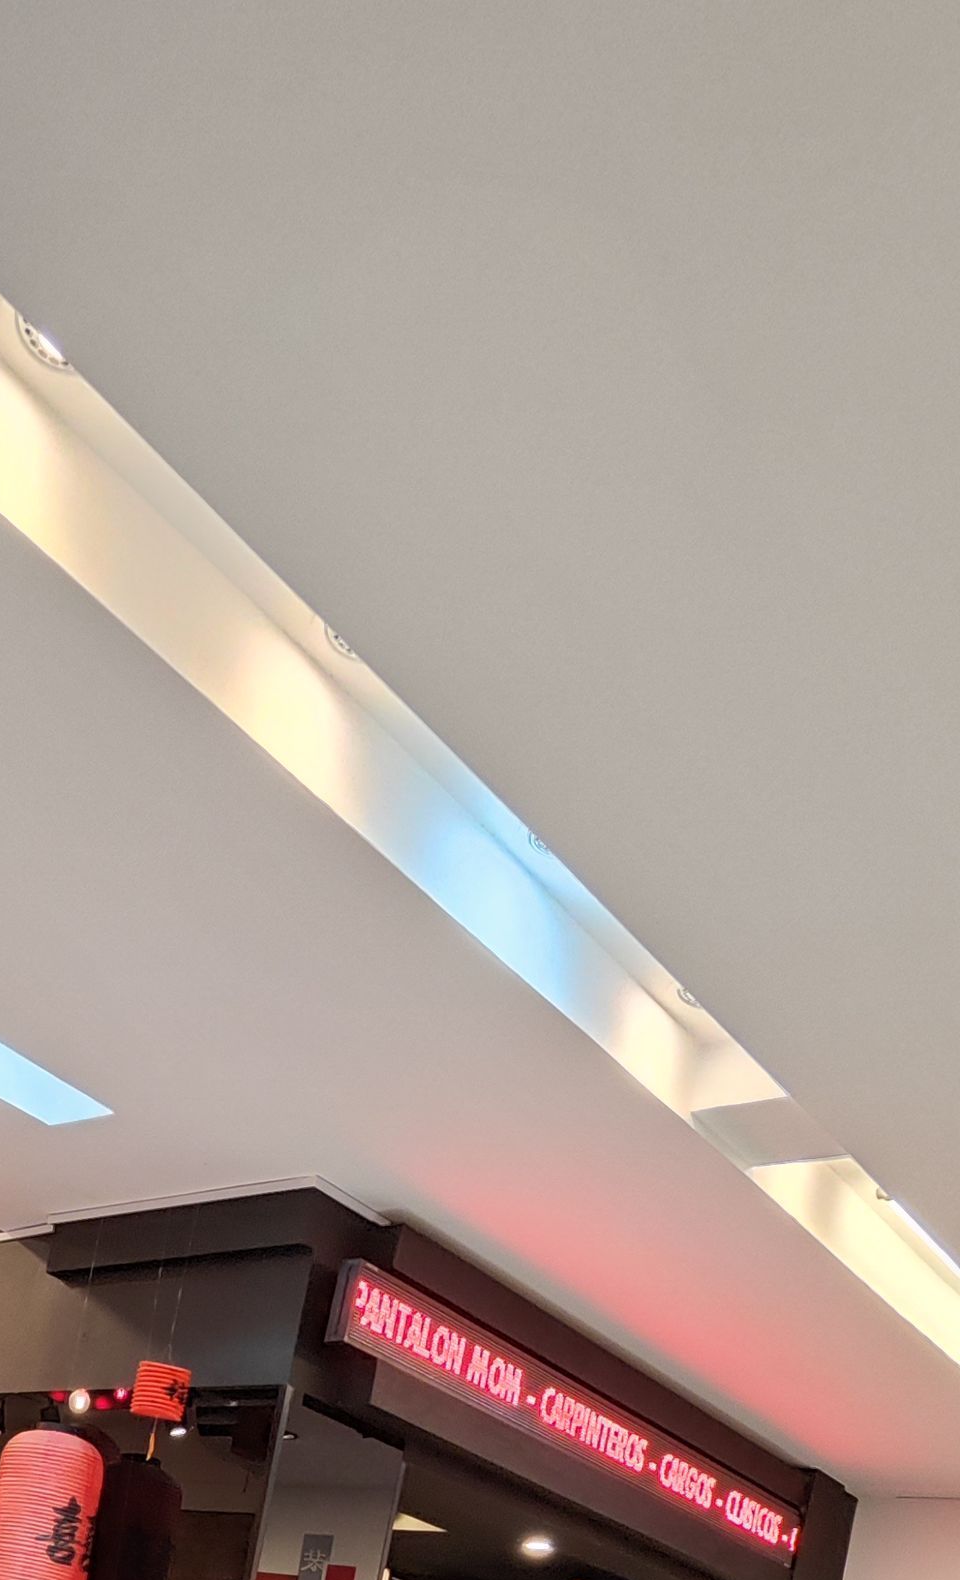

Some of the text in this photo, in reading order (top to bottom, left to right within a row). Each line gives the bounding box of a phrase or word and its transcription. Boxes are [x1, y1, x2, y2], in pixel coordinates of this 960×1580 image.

[465, 1344, 523, 1406] MOM
[540, 1386, 648, 1473] CARPINTEROS
[659, 1453, 717, 1510] CARGOS
[725, 1490, 784, 1545] CLASICOS
